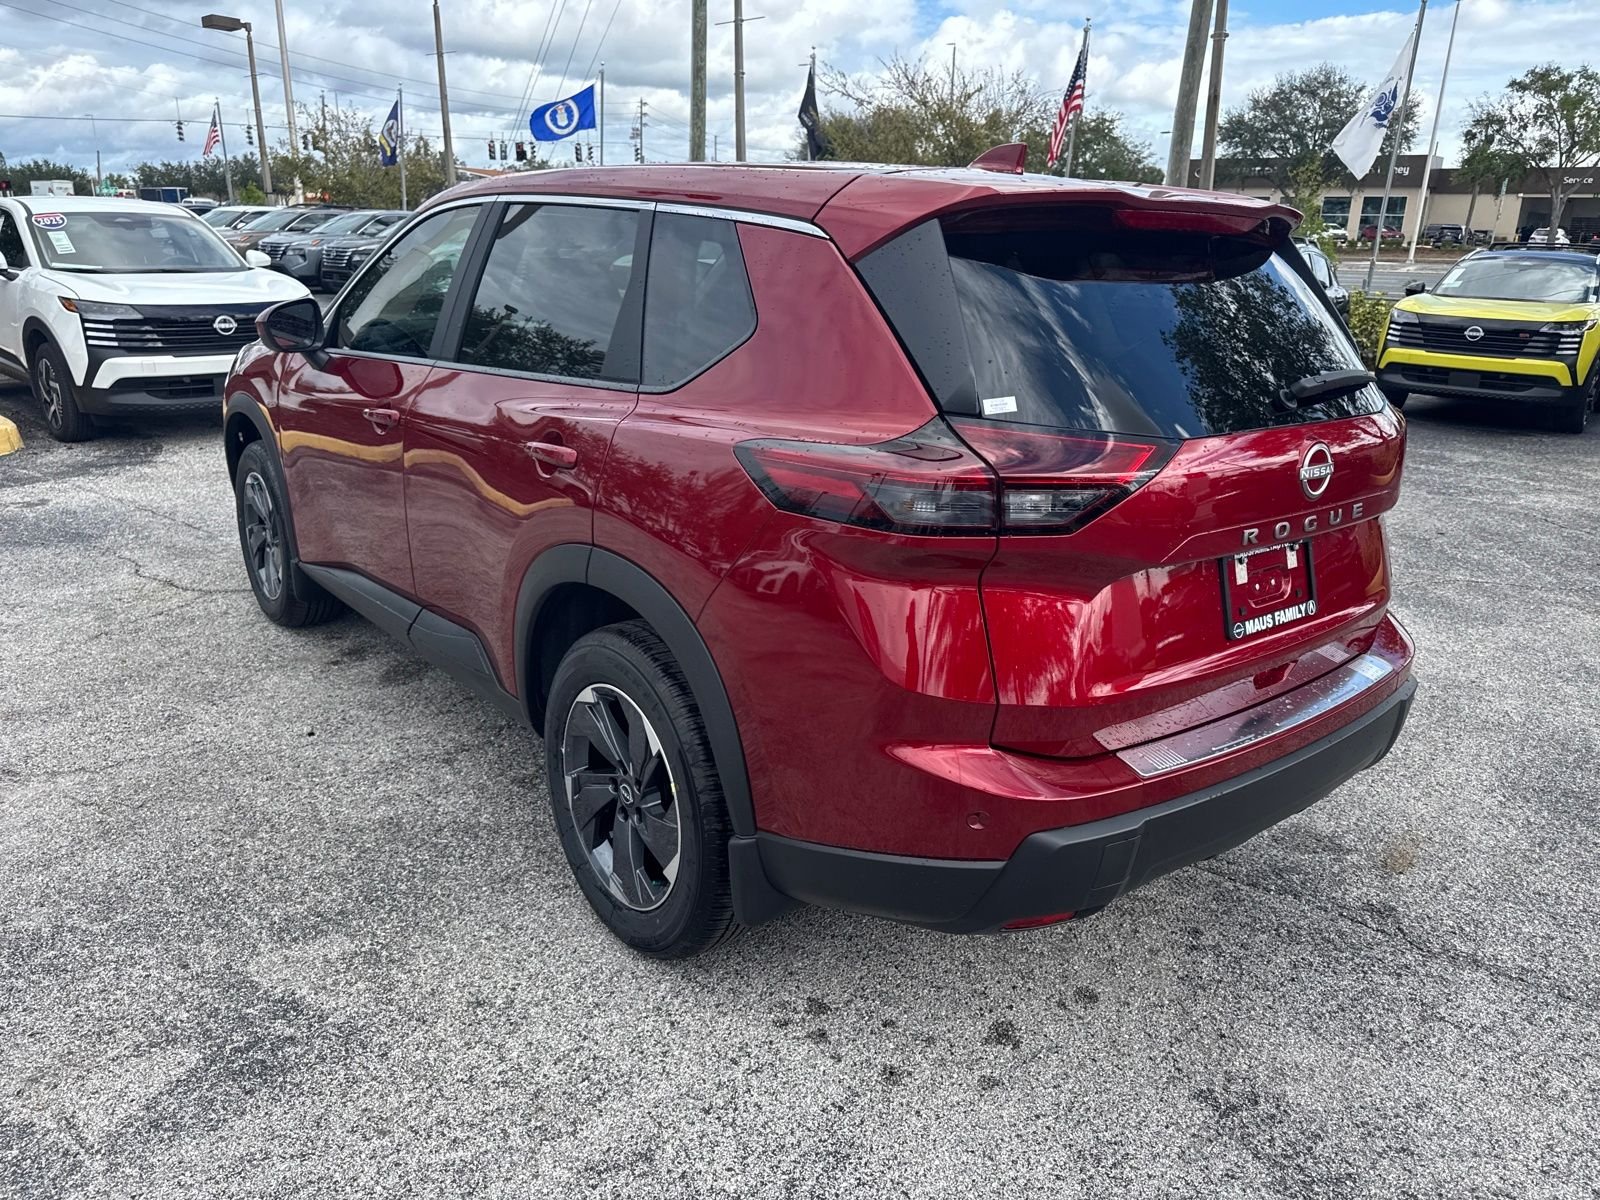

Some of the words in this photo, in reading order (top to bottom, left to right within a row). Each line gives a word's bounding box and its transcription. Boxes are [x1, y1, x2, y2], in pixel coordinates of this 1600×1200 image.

[1562, 176, 1594, 184] Servce
[36, 216, 63, 225] 2025
[1301, 464, 1334, 479] NISSAN
[1242, 502, 1363, 546] ROGUE
[1245, 613, 1274, 636] MAUS
[1274, 602, 1307, 626] FAMILY
